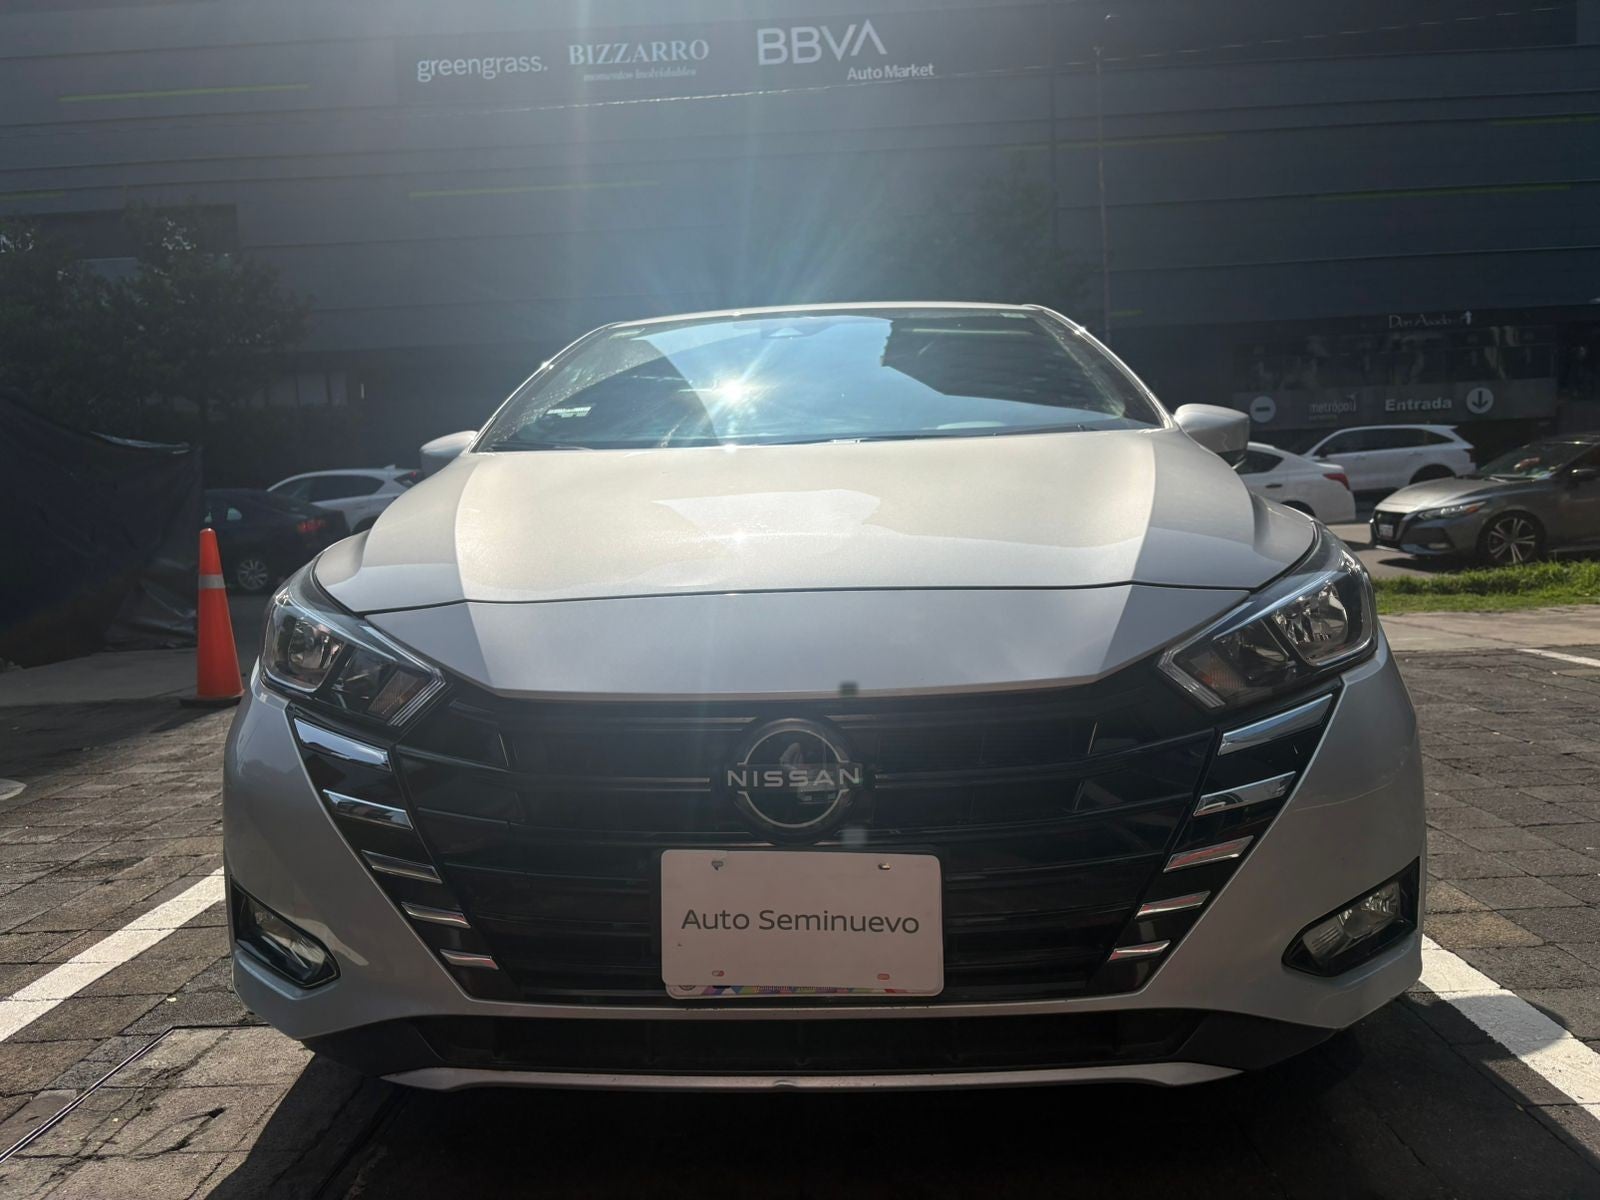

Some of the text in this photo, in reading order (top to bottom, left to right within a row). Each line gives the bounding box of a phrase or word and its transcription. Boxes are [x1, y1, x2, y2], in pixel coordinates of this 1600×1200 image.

[568, 39, 710, 65] BIZZARRO
[757, 18, 888, 65] BBVA
[417, 55, 548, 82] greengrass.
[847, 63, 935, 81] Auto Market
[1385, 397, 1453, 412] Entrada
[727, 767, 860, 788] NISSAN
[681, 909, 920, 935] Auto Seminuevo
